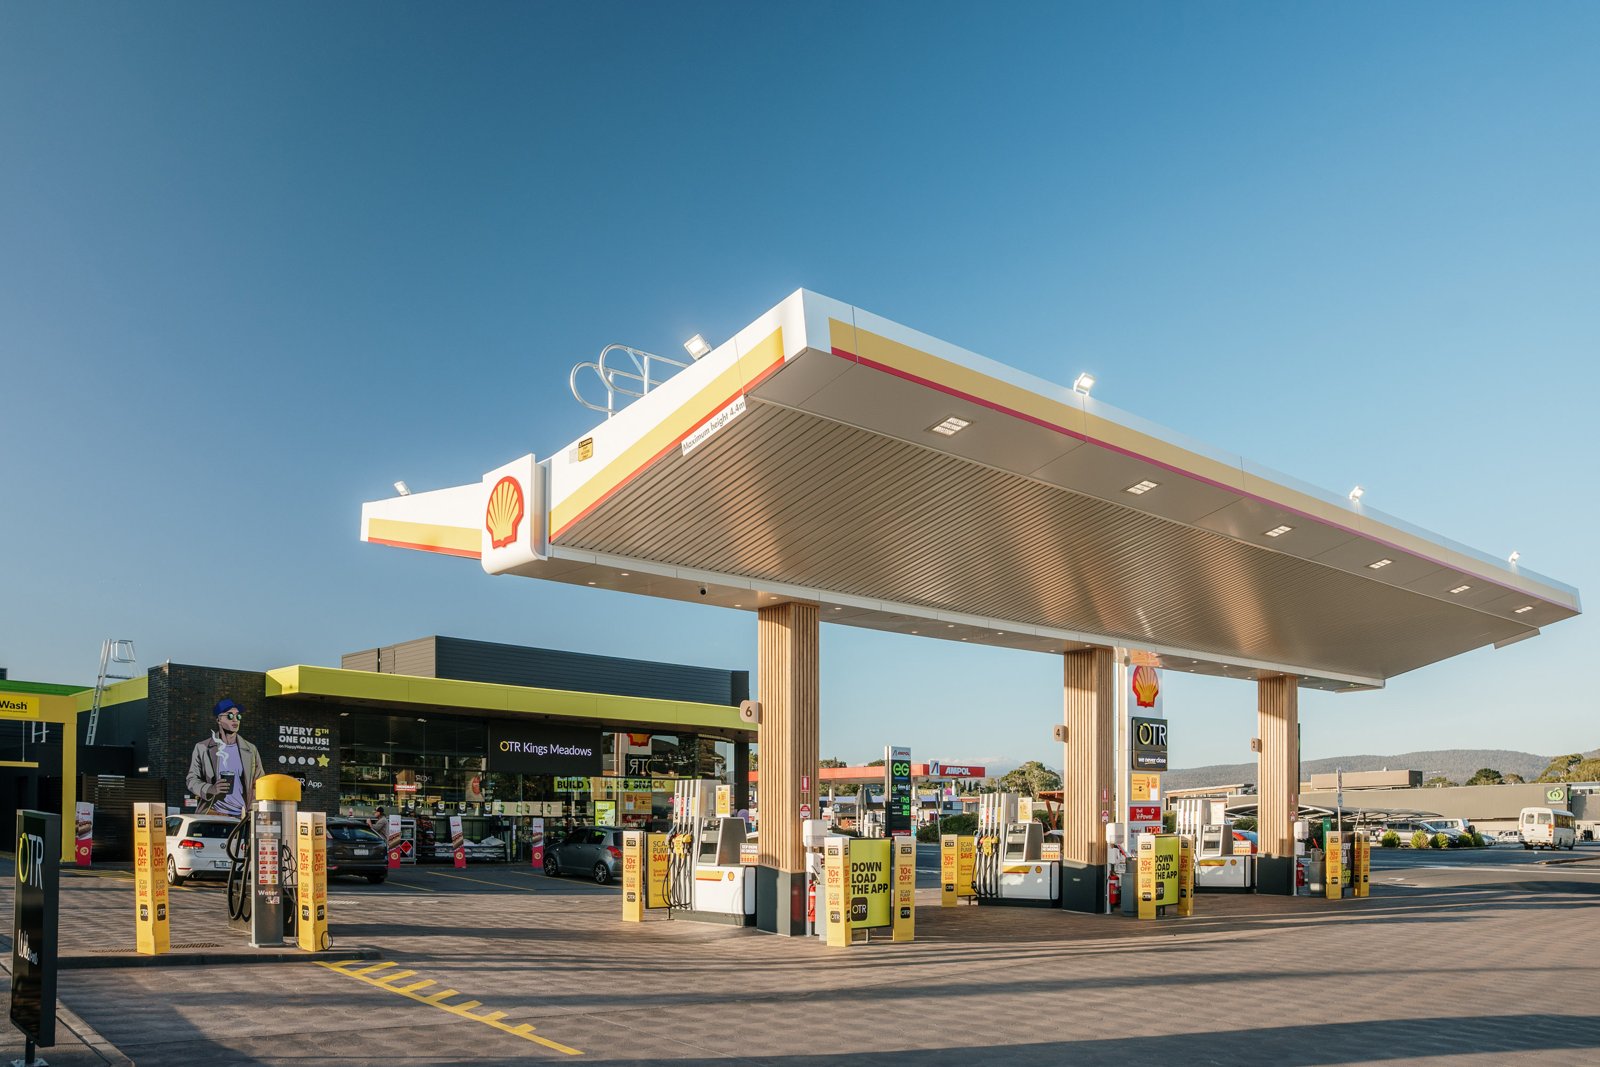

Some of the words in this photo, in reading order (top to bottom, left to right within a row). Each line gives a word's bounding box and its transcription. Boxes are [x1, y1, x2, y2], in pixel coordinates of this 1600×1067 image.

[683, 428, 710, 451] Maximum
[711, 412, 729, 427] height
[730, 401, 745, 416] 4.4m
[0, 700, 27, 710] Wash
[746, 706, 753, 717] 6
[280, 725, 313, 736] EVERY
[315, 728, 329, 737] 5TH
[1056, 728, 1061, 737] 4
[1139, 722, 1167, 746] OTR
[279, 735, 298, 744] ONE
[299, 737, 314, 745] ON
[315, 738, 330, 746] US!
[500, 740, 521, 752] OTR
[523, 742, 548, 756] Kings
[550, 744, 592, 757] Meadows
[945, 766, 971, 775] AMPOL
[308, 780, 322, 788] App
[557, 780, 584, 789] BUILD
[633, 780, 666, 790] SNACK
[137, 847, 147, 857] 10¢
[154, 847, 163, 857] 10¢
[18, 832, 44, 890] OTR
[653, 854, 668, 862] $AV
[852, 862, 882, 872] DOWN
[900, 867, 911, 875] 10¢
[1155, 863, 1170, 872] OAD
[828, 869, 839, 877] 10¢
[1166, 871, 1178, 879] APP
[852, 873, 877, 884] LOAD
[851, 884, 869, 894] THE
[871, 883, 888, 894] APP
[852, 904, 867, 914] OTR
